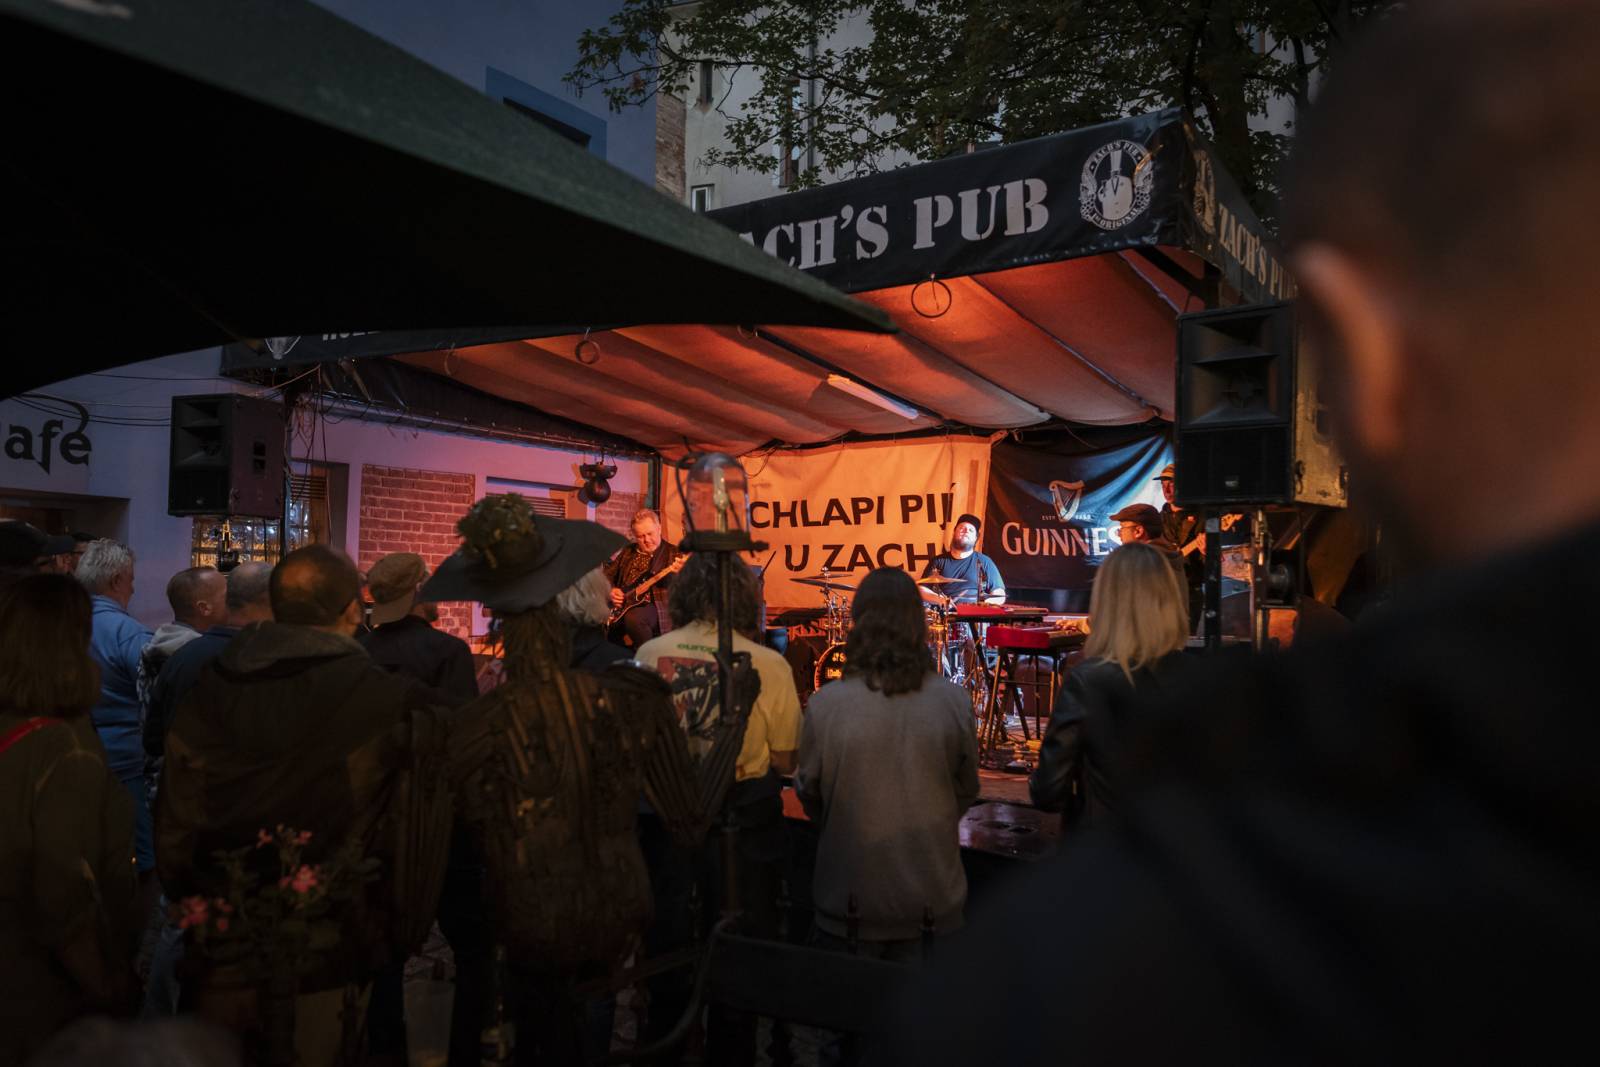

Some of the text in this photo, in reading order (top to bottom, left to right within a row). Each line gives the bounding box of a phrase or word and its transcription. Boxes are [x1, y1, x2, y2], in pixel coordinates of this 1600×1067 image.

[739, 177, 1049, 270] CH'S PUB
[1218, 202, 1267, 286] ZACH'S
[750, 495, 885, 529] CHLAPI
[1002, 522, 1123, 557] GUINNES
[784, 543, 948, 573] U ZACH
